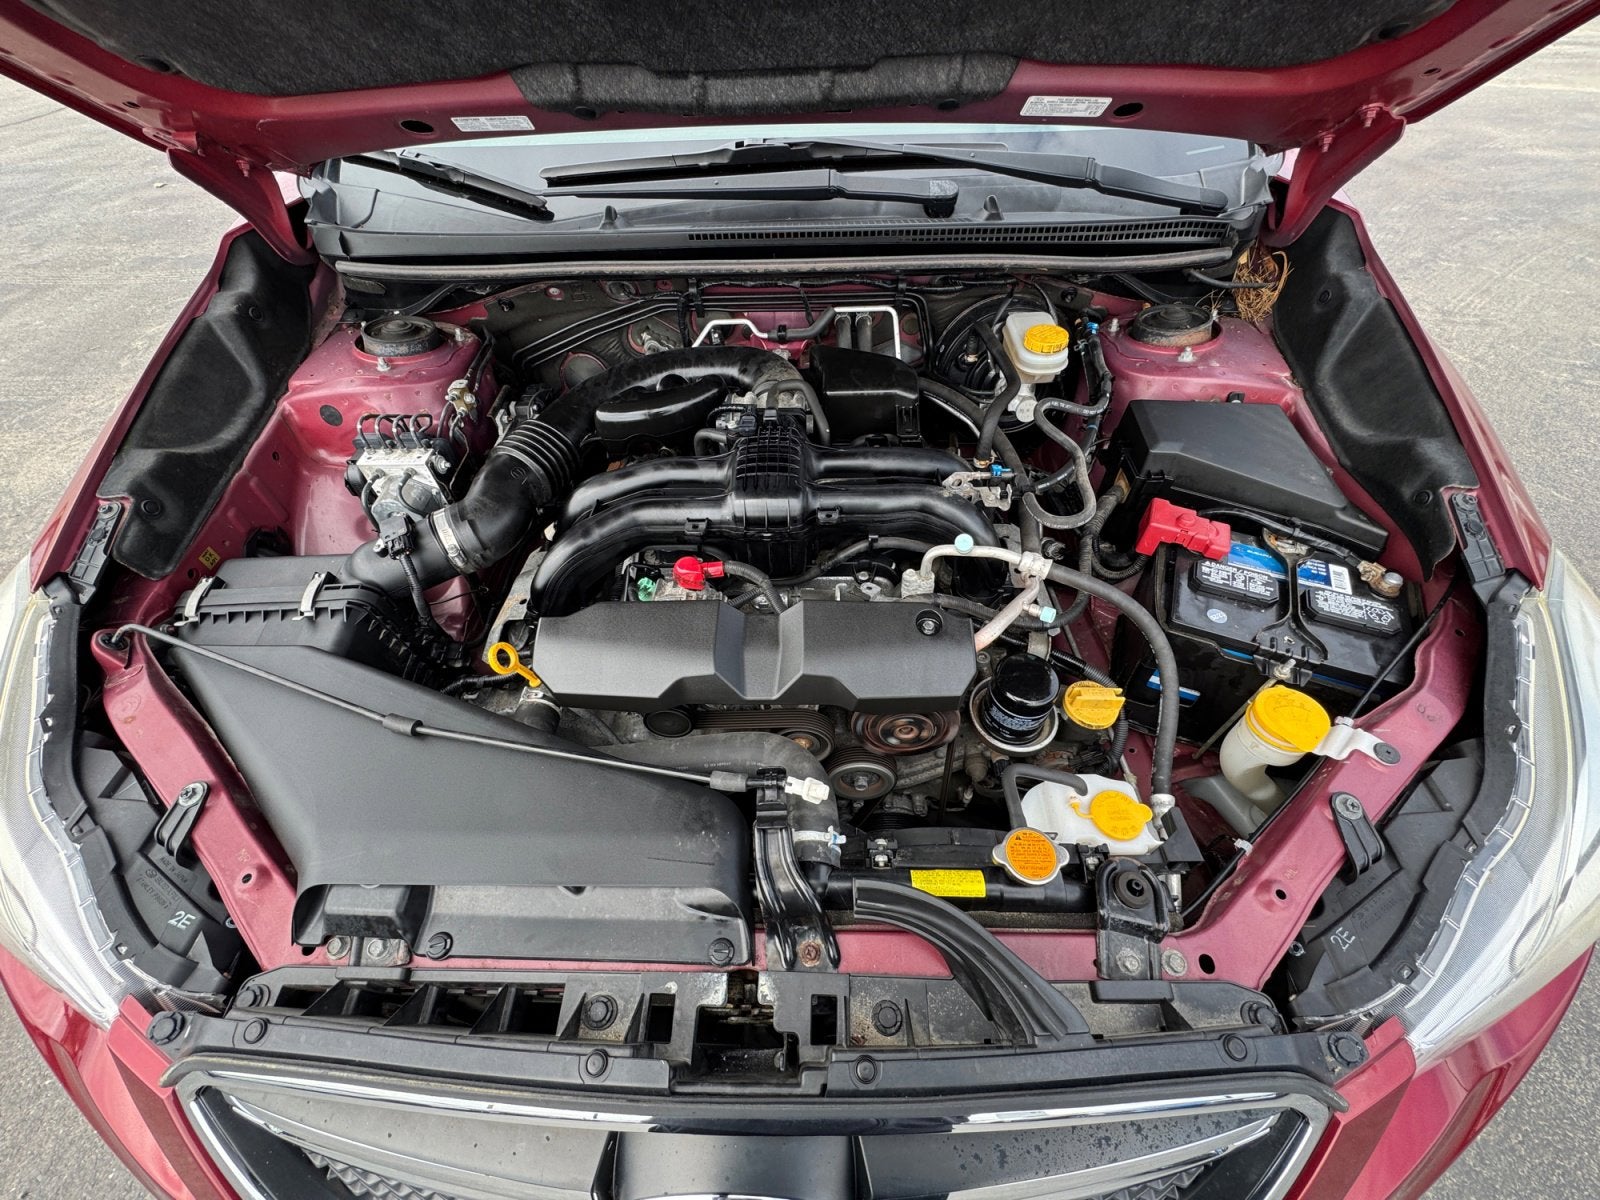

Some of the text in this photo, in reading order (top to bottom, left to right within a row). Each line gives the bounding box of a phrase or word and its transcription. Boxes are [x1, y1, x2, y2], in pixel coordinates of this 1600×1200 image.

[1210, 561, 1237, 573] DANGER
[1243, 570, 1268, 581] POISON
[168, 910, 196, 930] 2E
[1330, 926, 1356, 952] 2E
